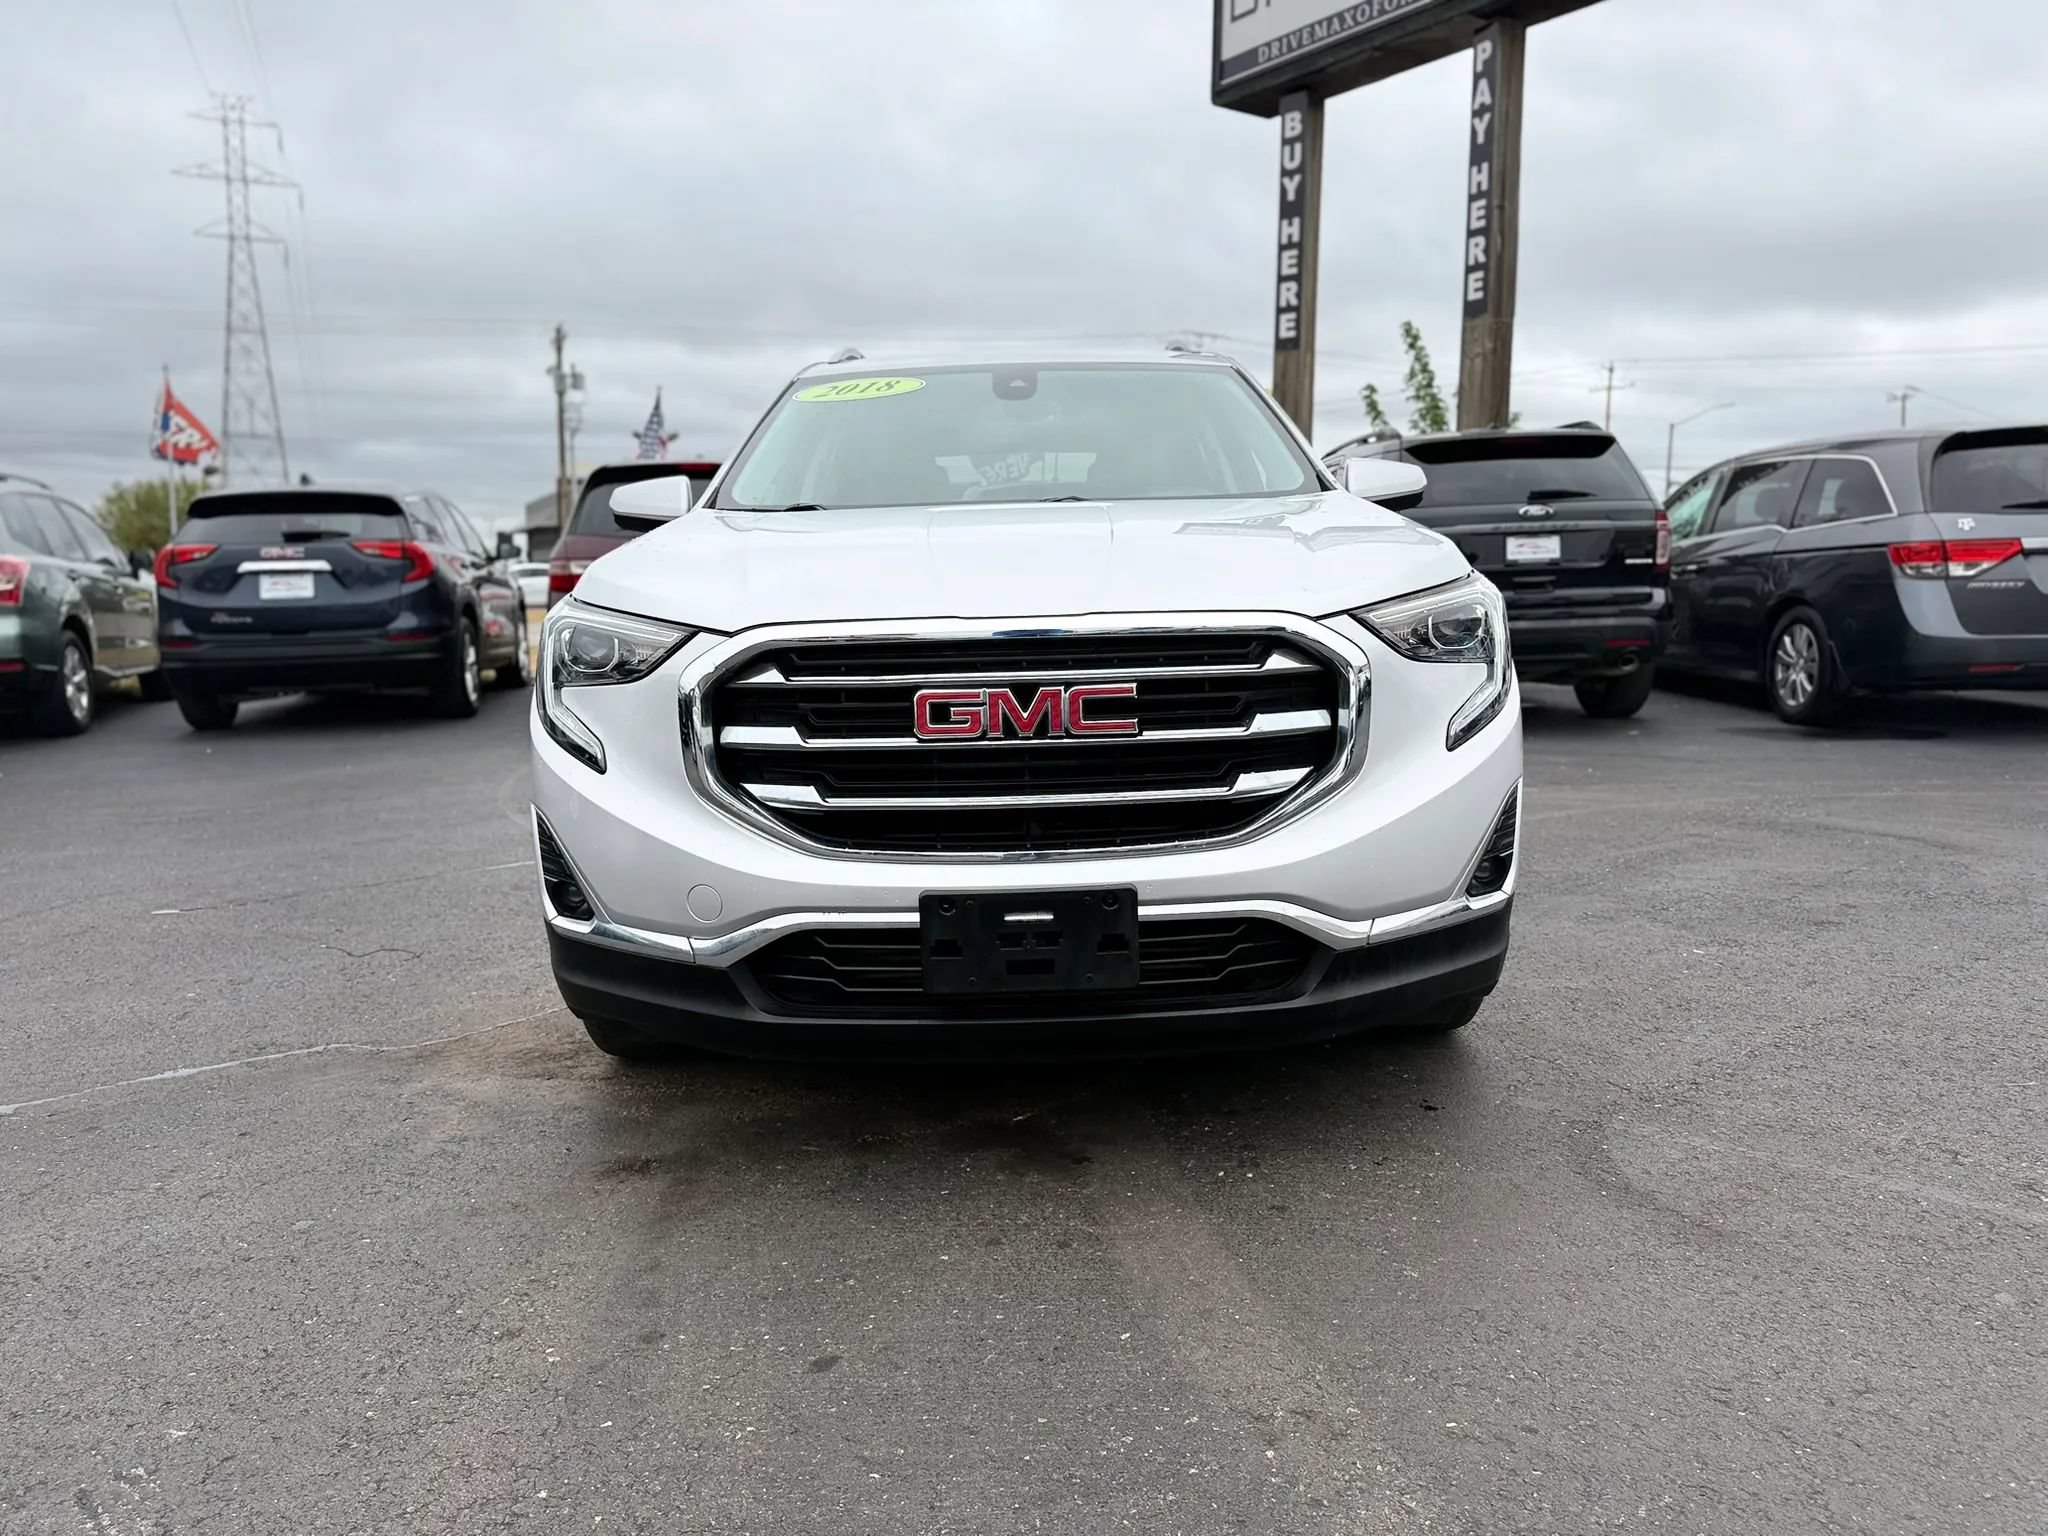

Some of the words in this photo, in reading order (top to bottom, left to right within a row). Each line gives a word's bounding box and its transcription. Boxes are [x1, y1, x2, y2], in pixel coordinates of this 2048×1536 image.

[1258, 0, 1413, 63] DRIVEMAXOFO
[1472, 40, 1492, 144] PAY
[1282, 111, 1303, 201] BUY
[1466, 162, 1489, 301] HERE
[1278, 217, 1301, 340] HERE
[812, 380, 901, 399] 2018
[914, 683, 1138, 739] GMC
